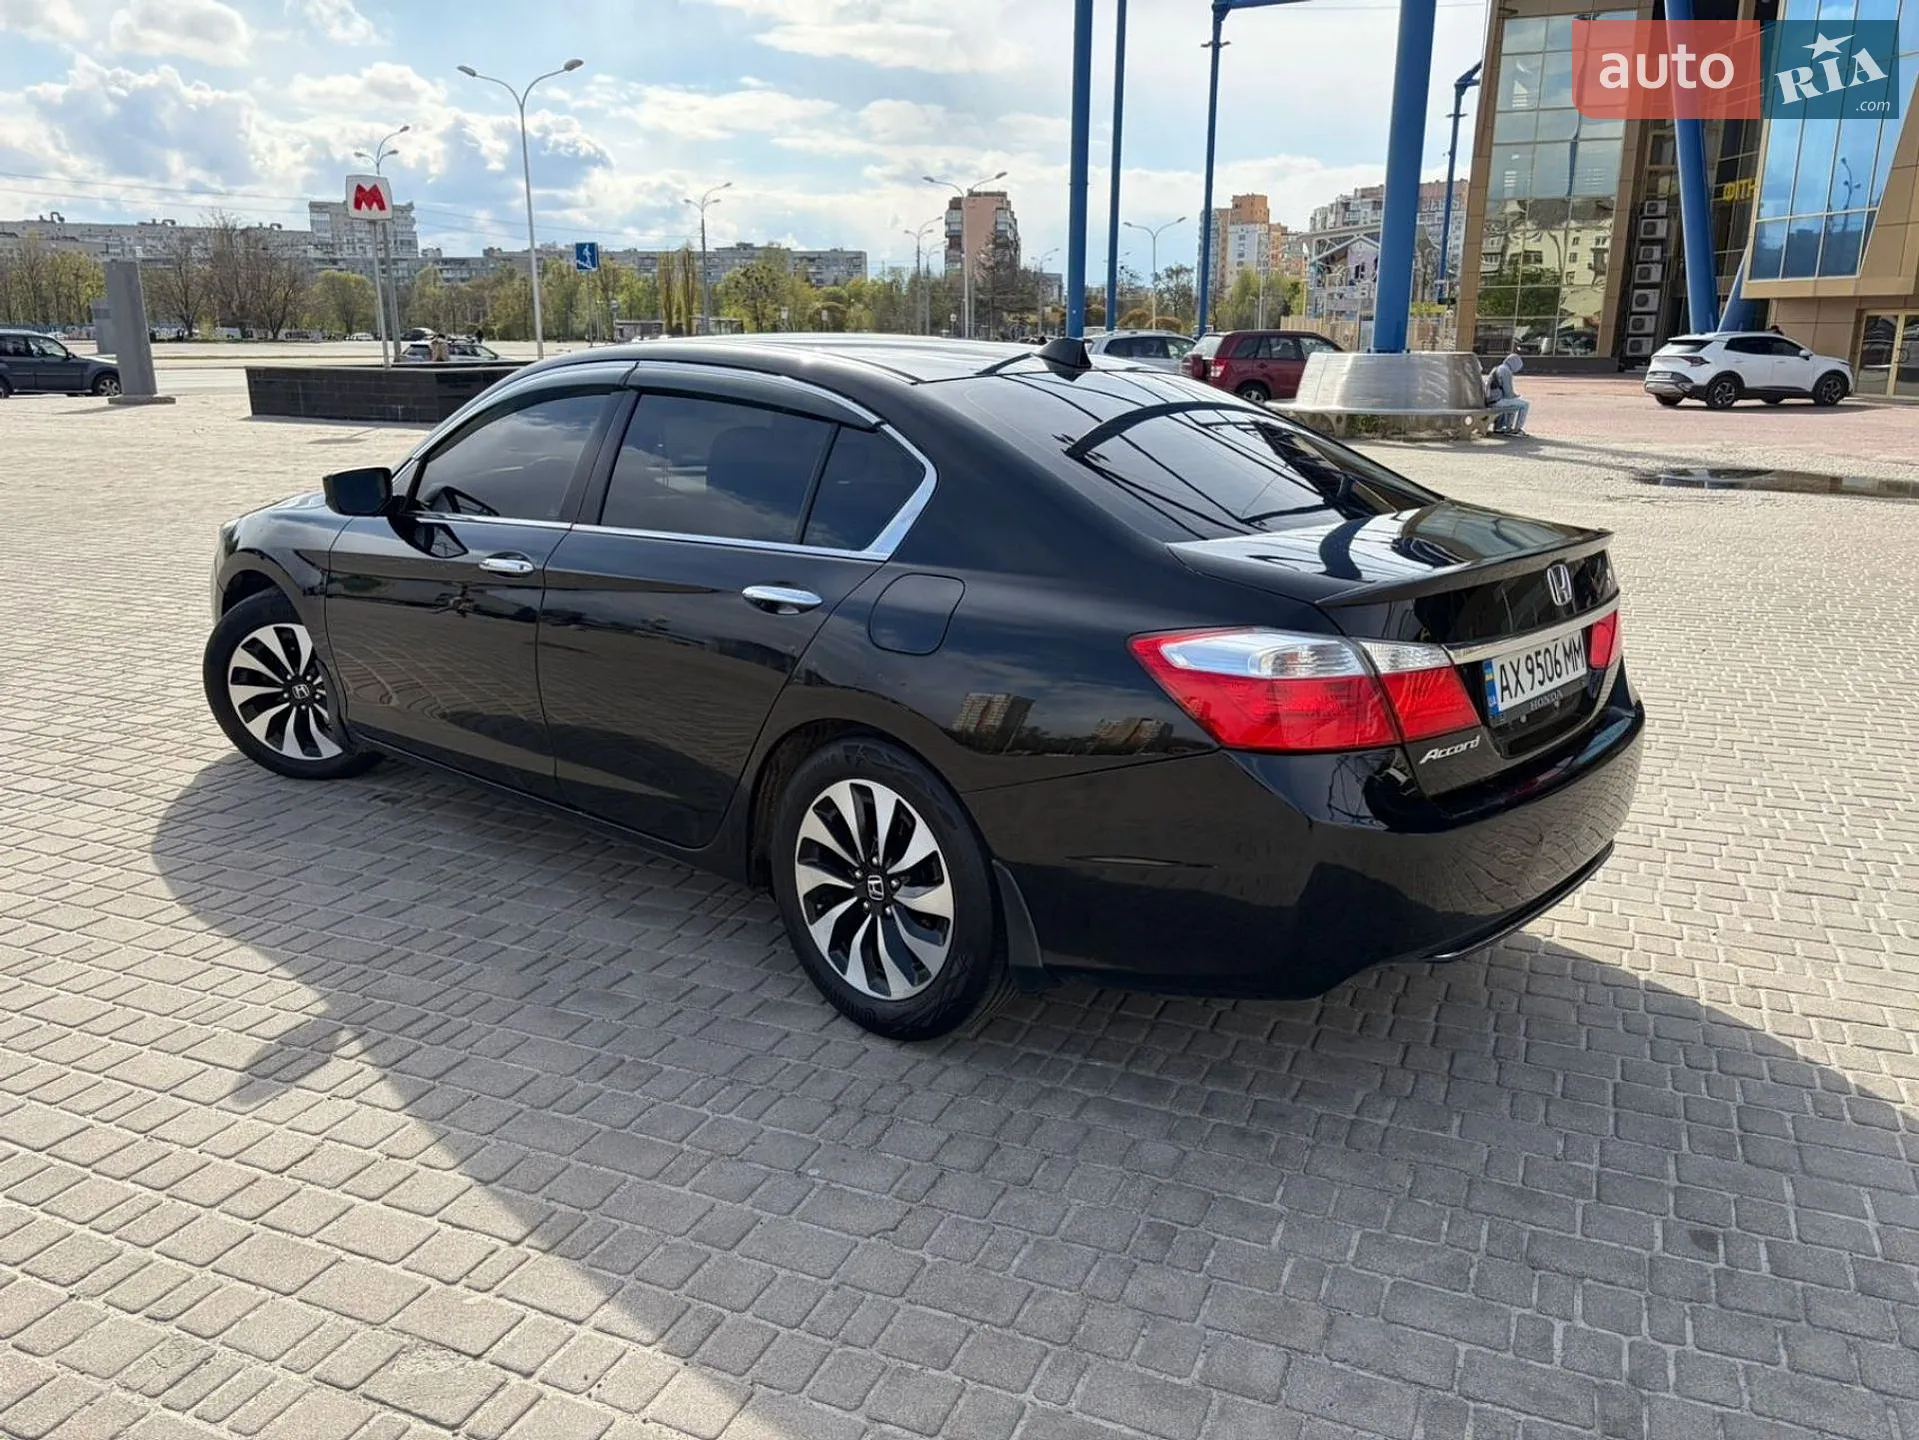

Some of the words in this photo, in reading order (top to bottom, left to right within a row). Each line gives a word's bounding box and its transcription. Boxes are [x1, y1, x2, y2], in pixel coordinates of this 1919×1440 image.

[1500, 658, 1525, 703] AX
[1525, 643, 1563, 691] 9506
[1562, 636, 1585, 675] MM
[1419, 735, 1480, 765] Accord
